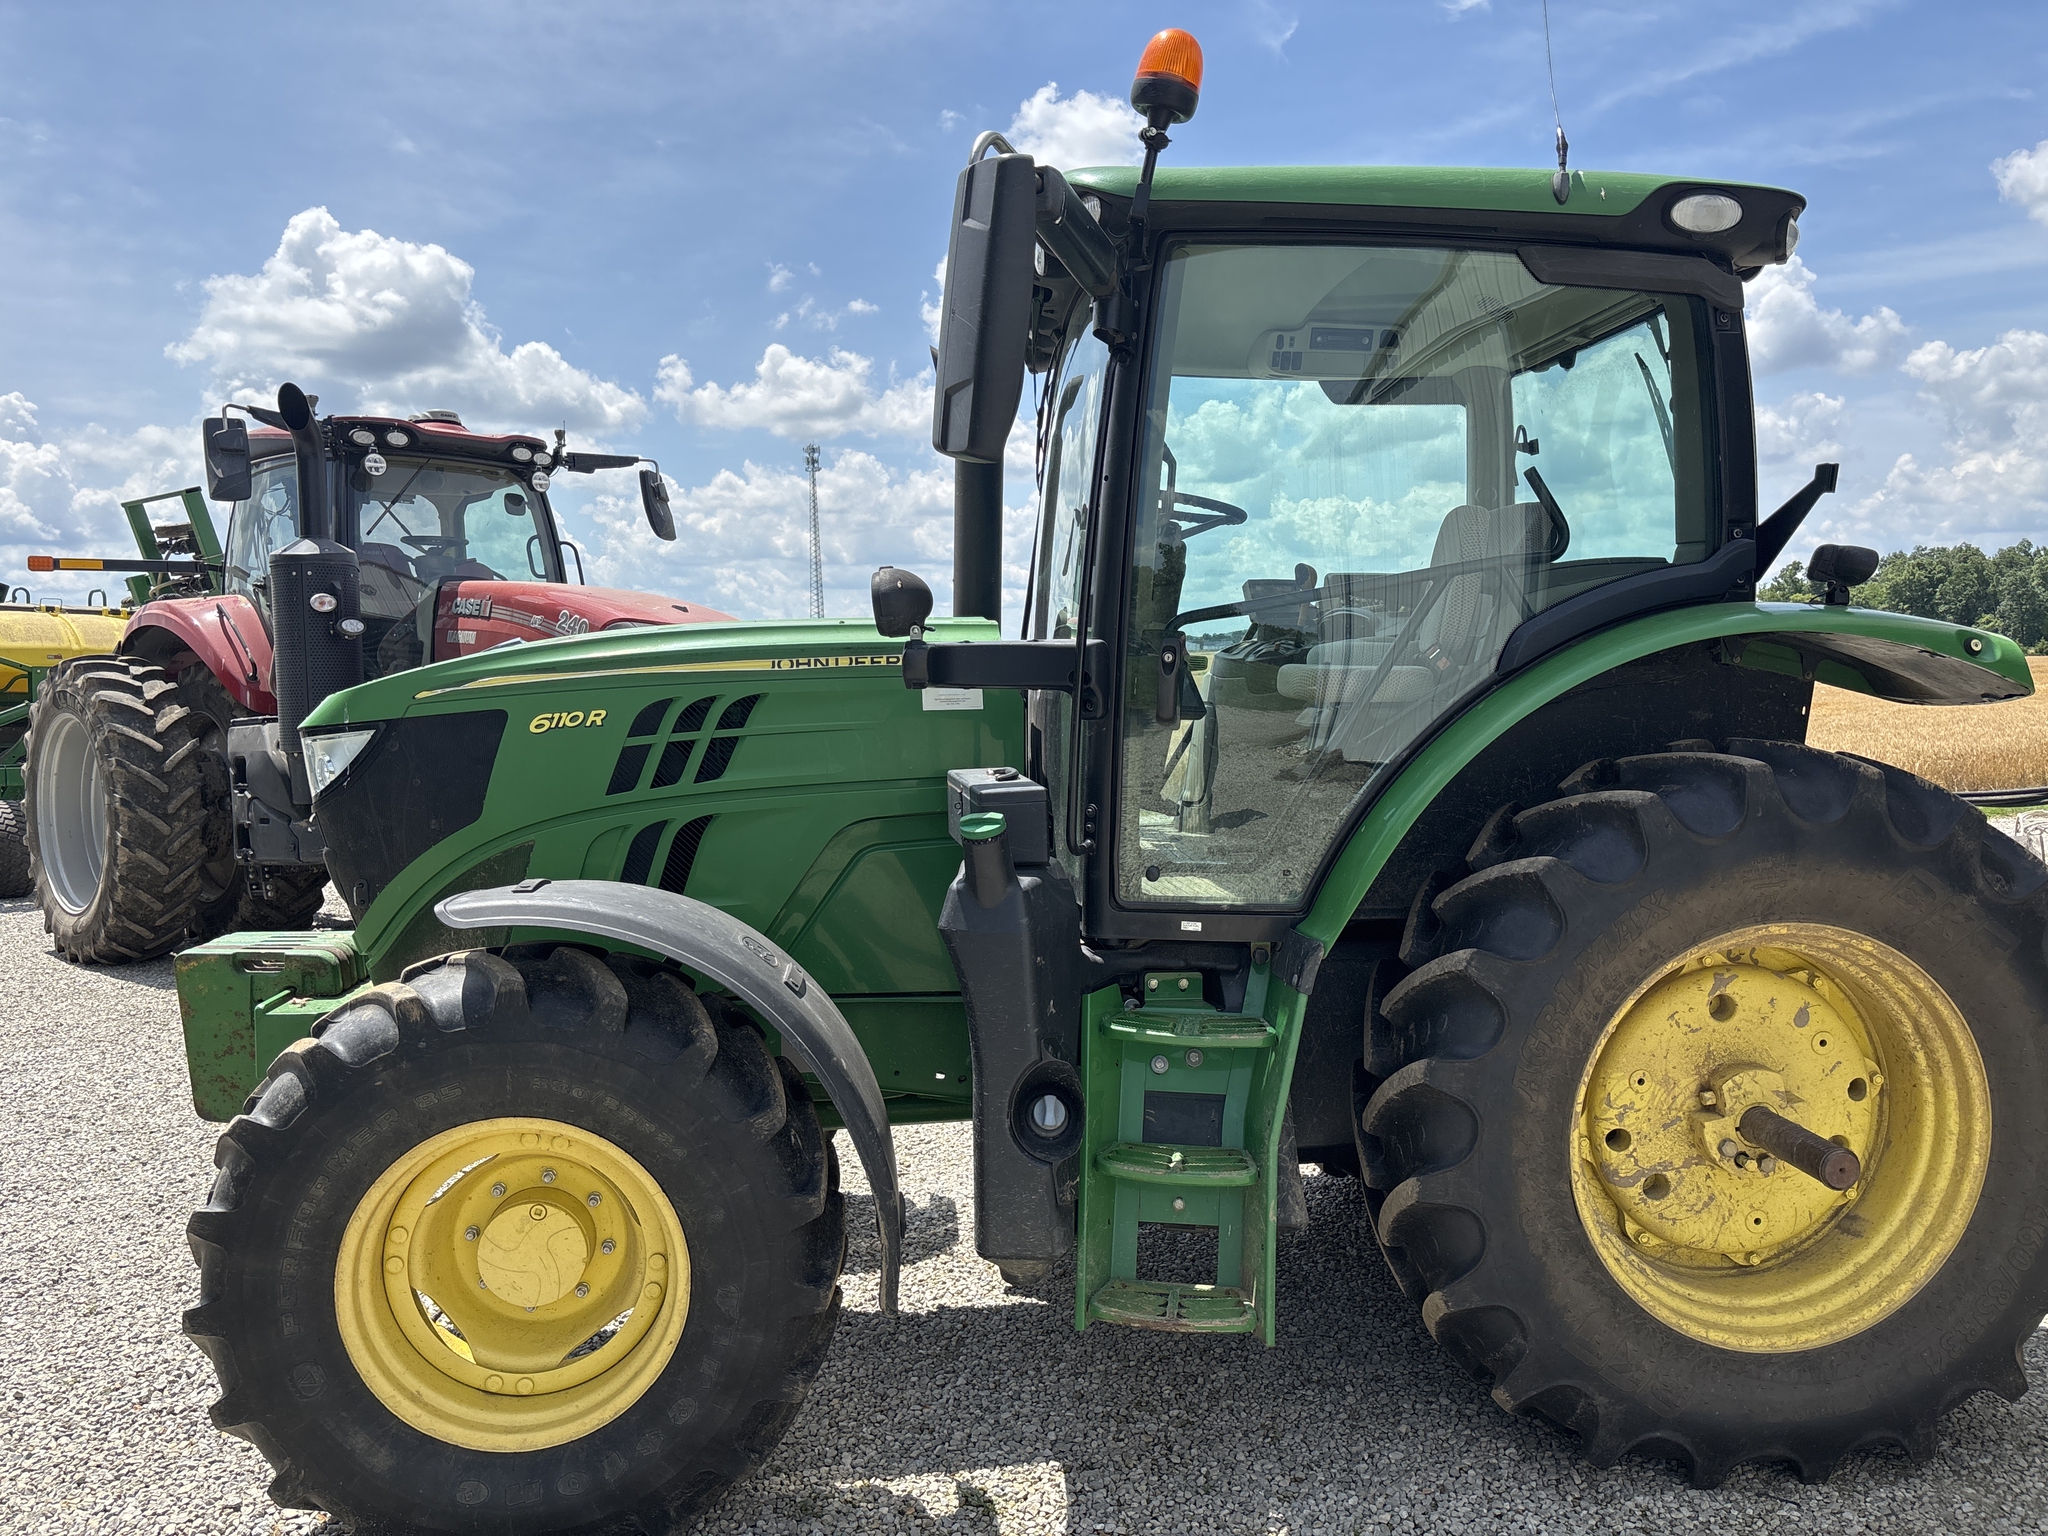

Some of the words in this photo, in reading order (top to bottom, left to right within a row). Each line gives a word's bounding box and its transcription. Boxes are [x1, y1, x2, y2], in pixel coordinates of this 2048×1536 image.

[452, 597, 480, 616] CASE
[556, 609, 589, 635] 240
[446, 630, 477, 644] MAGNUM
[771, 658, 829, 669] JOHN
[835, 656, 902, 667] DEER
[278, 1107, 400, 1337] PERFORMER
[414, 1081, 464, 1109] 85
